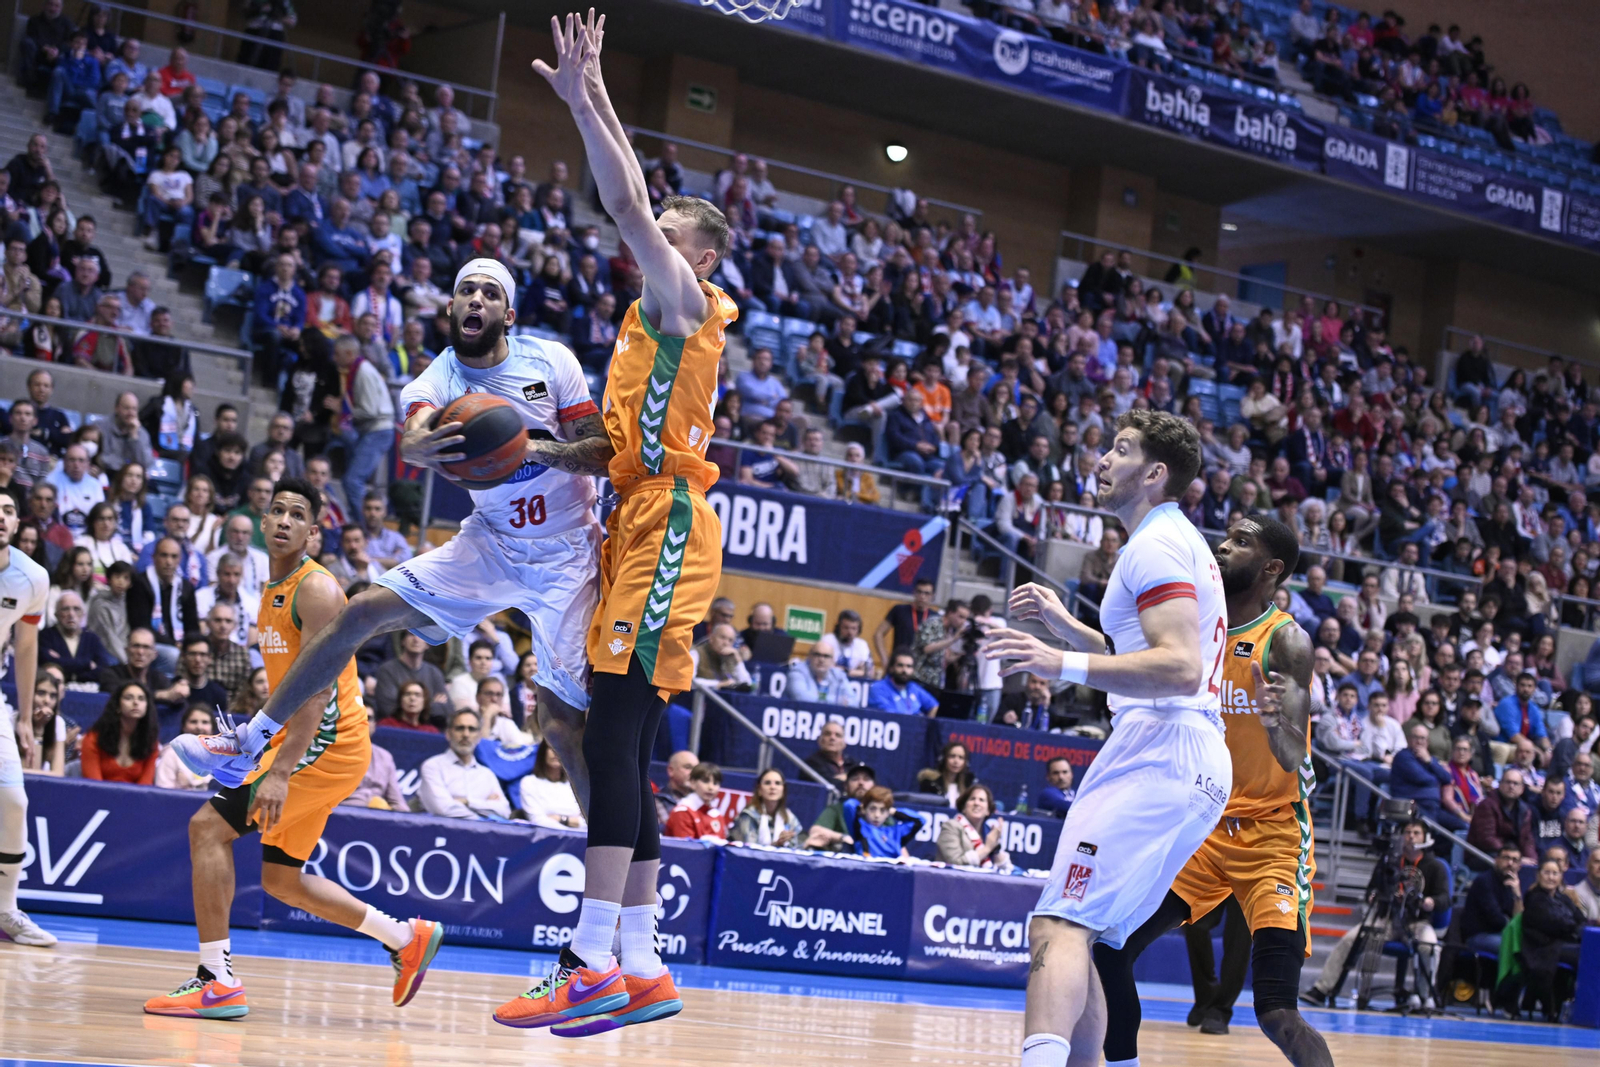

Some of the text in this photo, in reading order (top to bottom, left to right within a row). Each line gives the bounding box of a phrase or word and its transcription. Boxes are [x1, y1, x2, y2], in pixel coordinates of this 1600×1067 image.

[871, 1, 960, 46] cenor
[1324, 137, 1379, 171] GRADA
[1485, 183, 1536, 215] GRADA
[509, 495, 547, 529] 30
[706, 491, 808, 565] OBRA
[949, 733, 1012, 757] SANTIAGO
[1014, 742, 1031, 760] DE
[1195, 773, 1203, 788] A
[768, 904, 888, 937] INDUPANEL
[793, 940, 810, 960] &
[813, 938, 904, 967] Innovación
